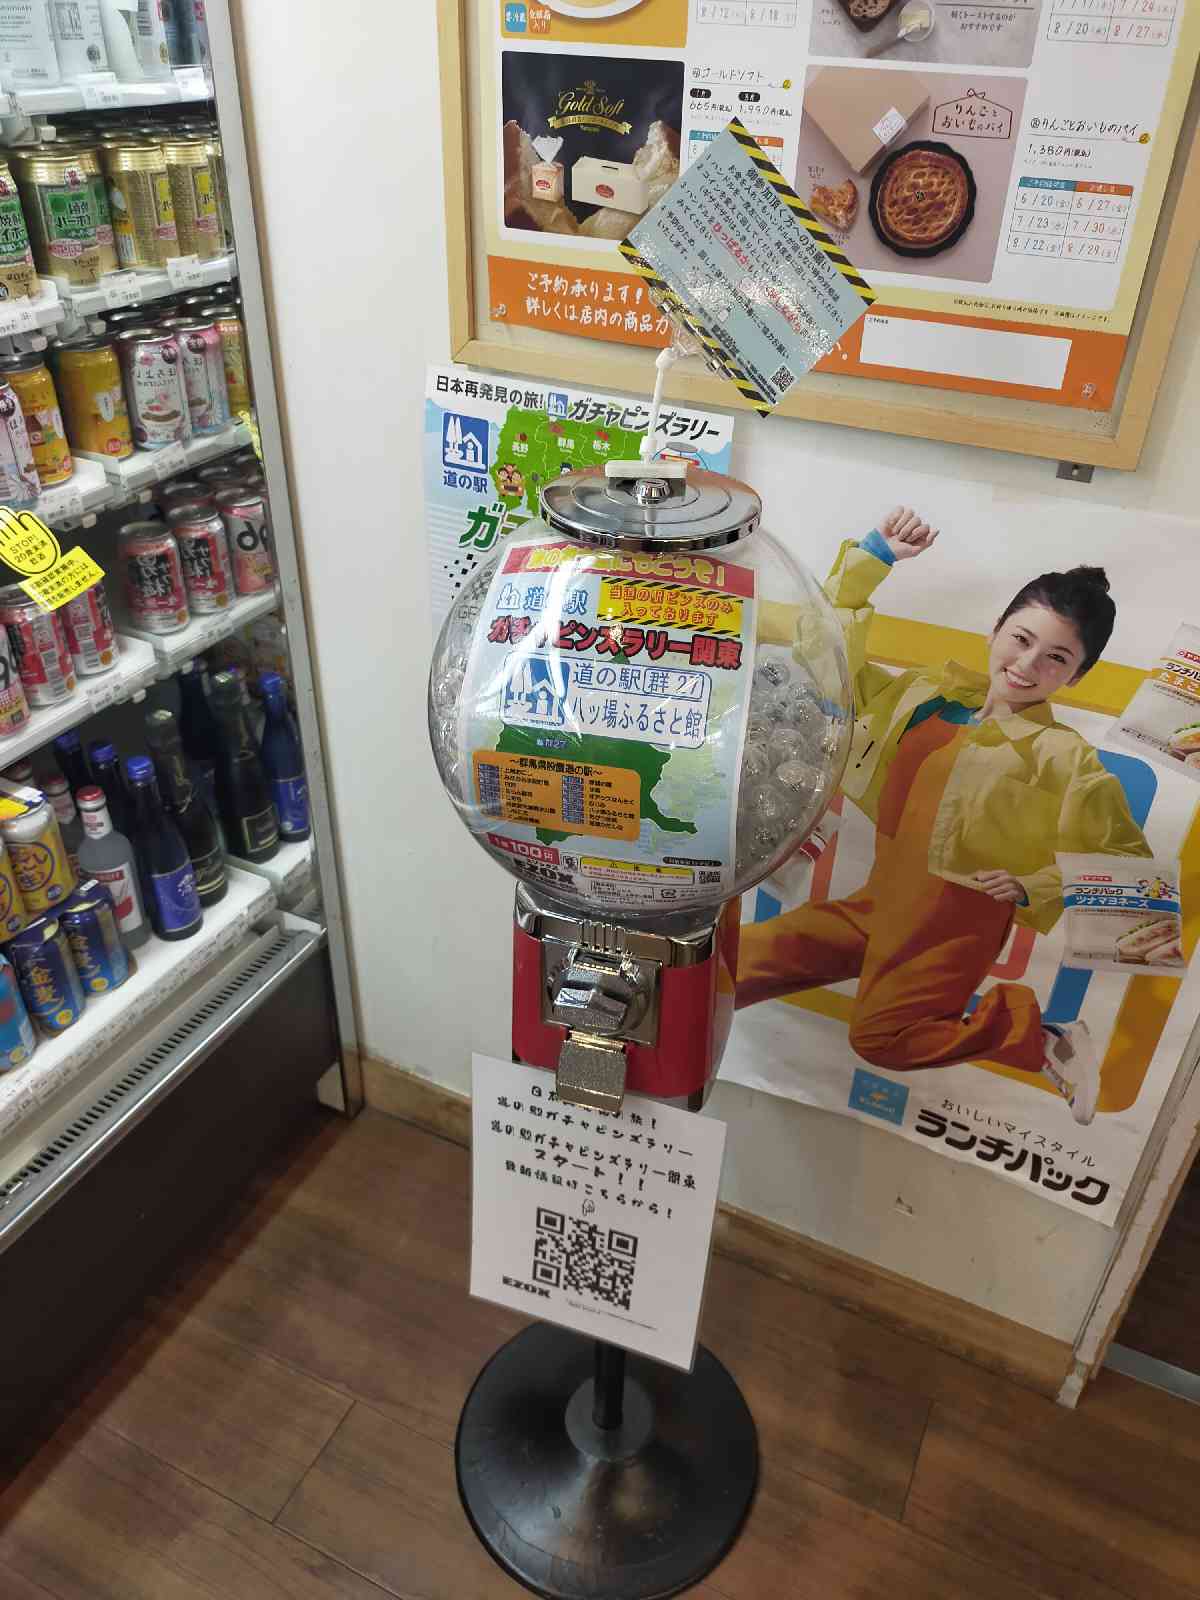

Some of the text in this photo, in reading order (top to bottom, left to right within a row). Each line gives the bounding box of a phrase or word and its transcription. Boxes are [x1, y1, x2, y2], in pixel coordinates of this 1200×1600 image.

[558, 91, 625, 117] Gold Soft
[436, 375, 545, 408] 日本再発見の旅!
[444, 469, 488, 493] 道の駅
[573, 662, 641, 691] 道の駅
[1165, 662, 1200, 682] ランチパ
[915, 1108, 1110, 1206] ランチパック
